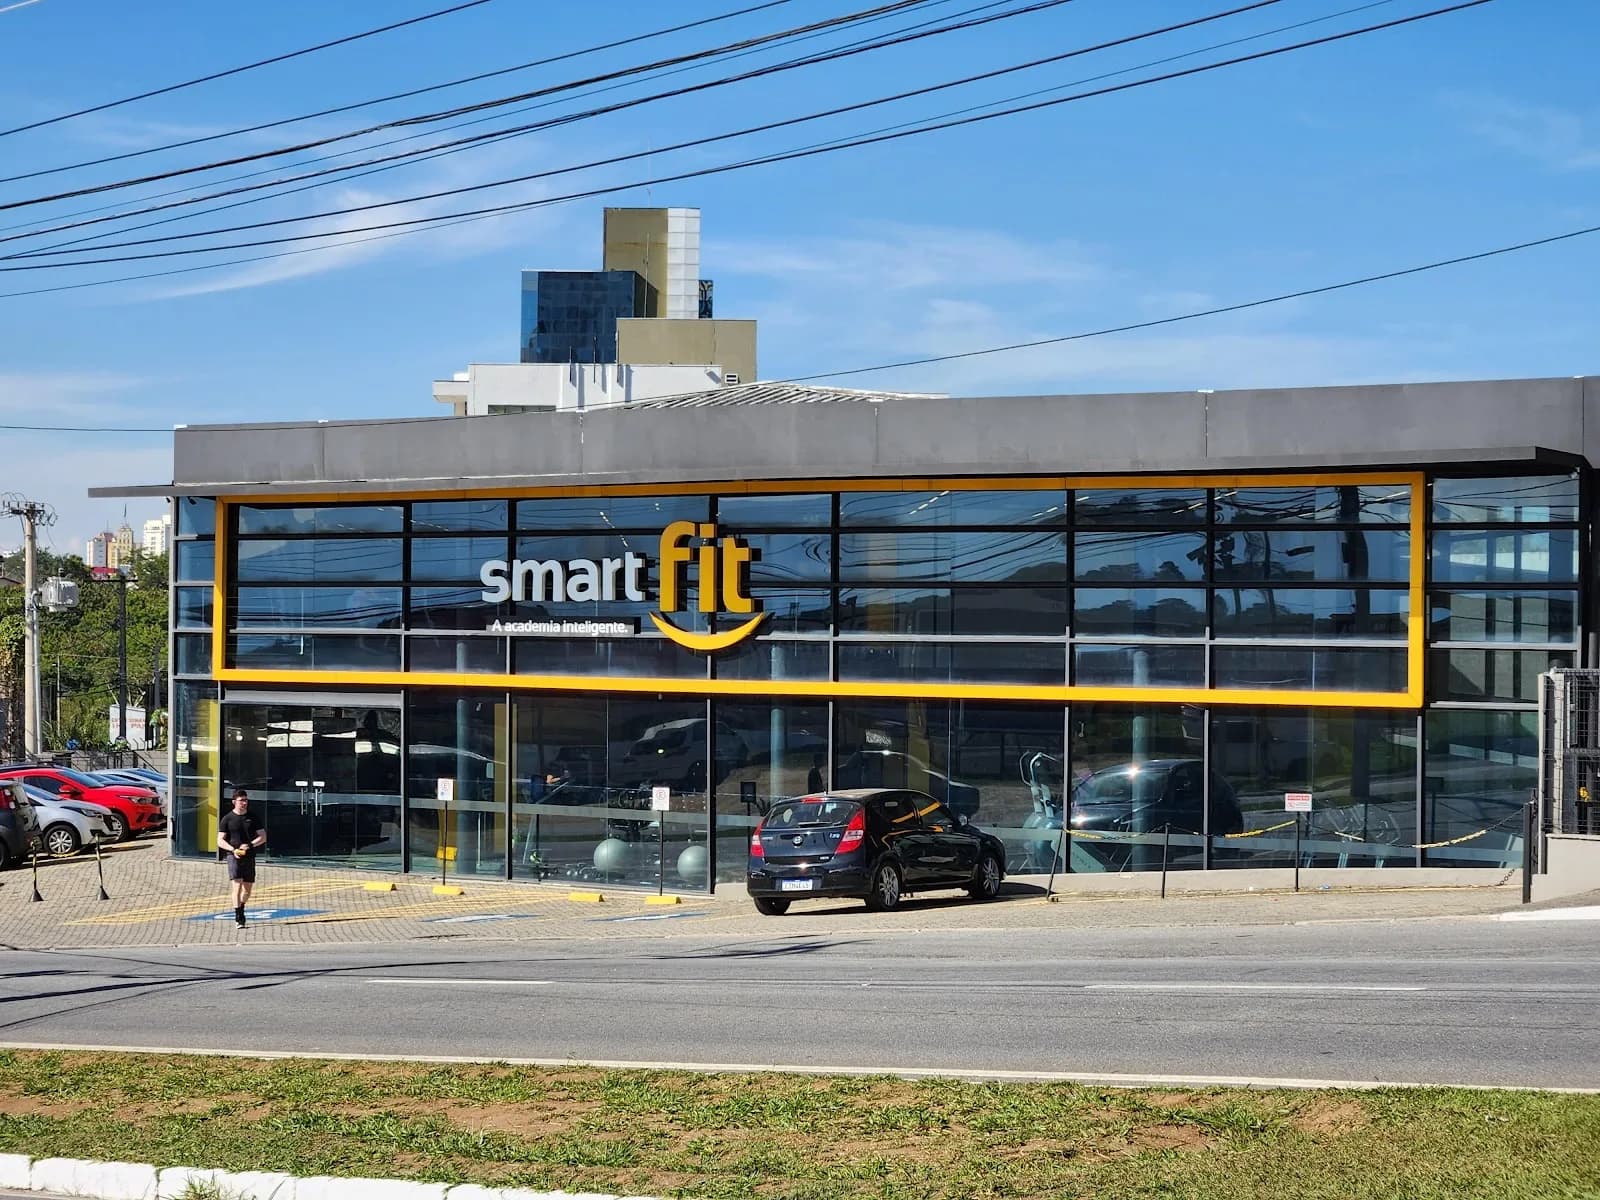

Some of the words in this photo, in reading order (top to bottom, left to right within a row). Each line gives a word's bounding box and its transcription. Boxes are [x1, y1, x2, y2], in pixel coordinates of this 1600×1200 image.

[480, 552, 646, 602] smart
[659, 521, 755, 613] fit
[491, 619, 502, 632] A
[504, 620, 560, 633] academia
[563, 620, 628, 636] inteligente.
